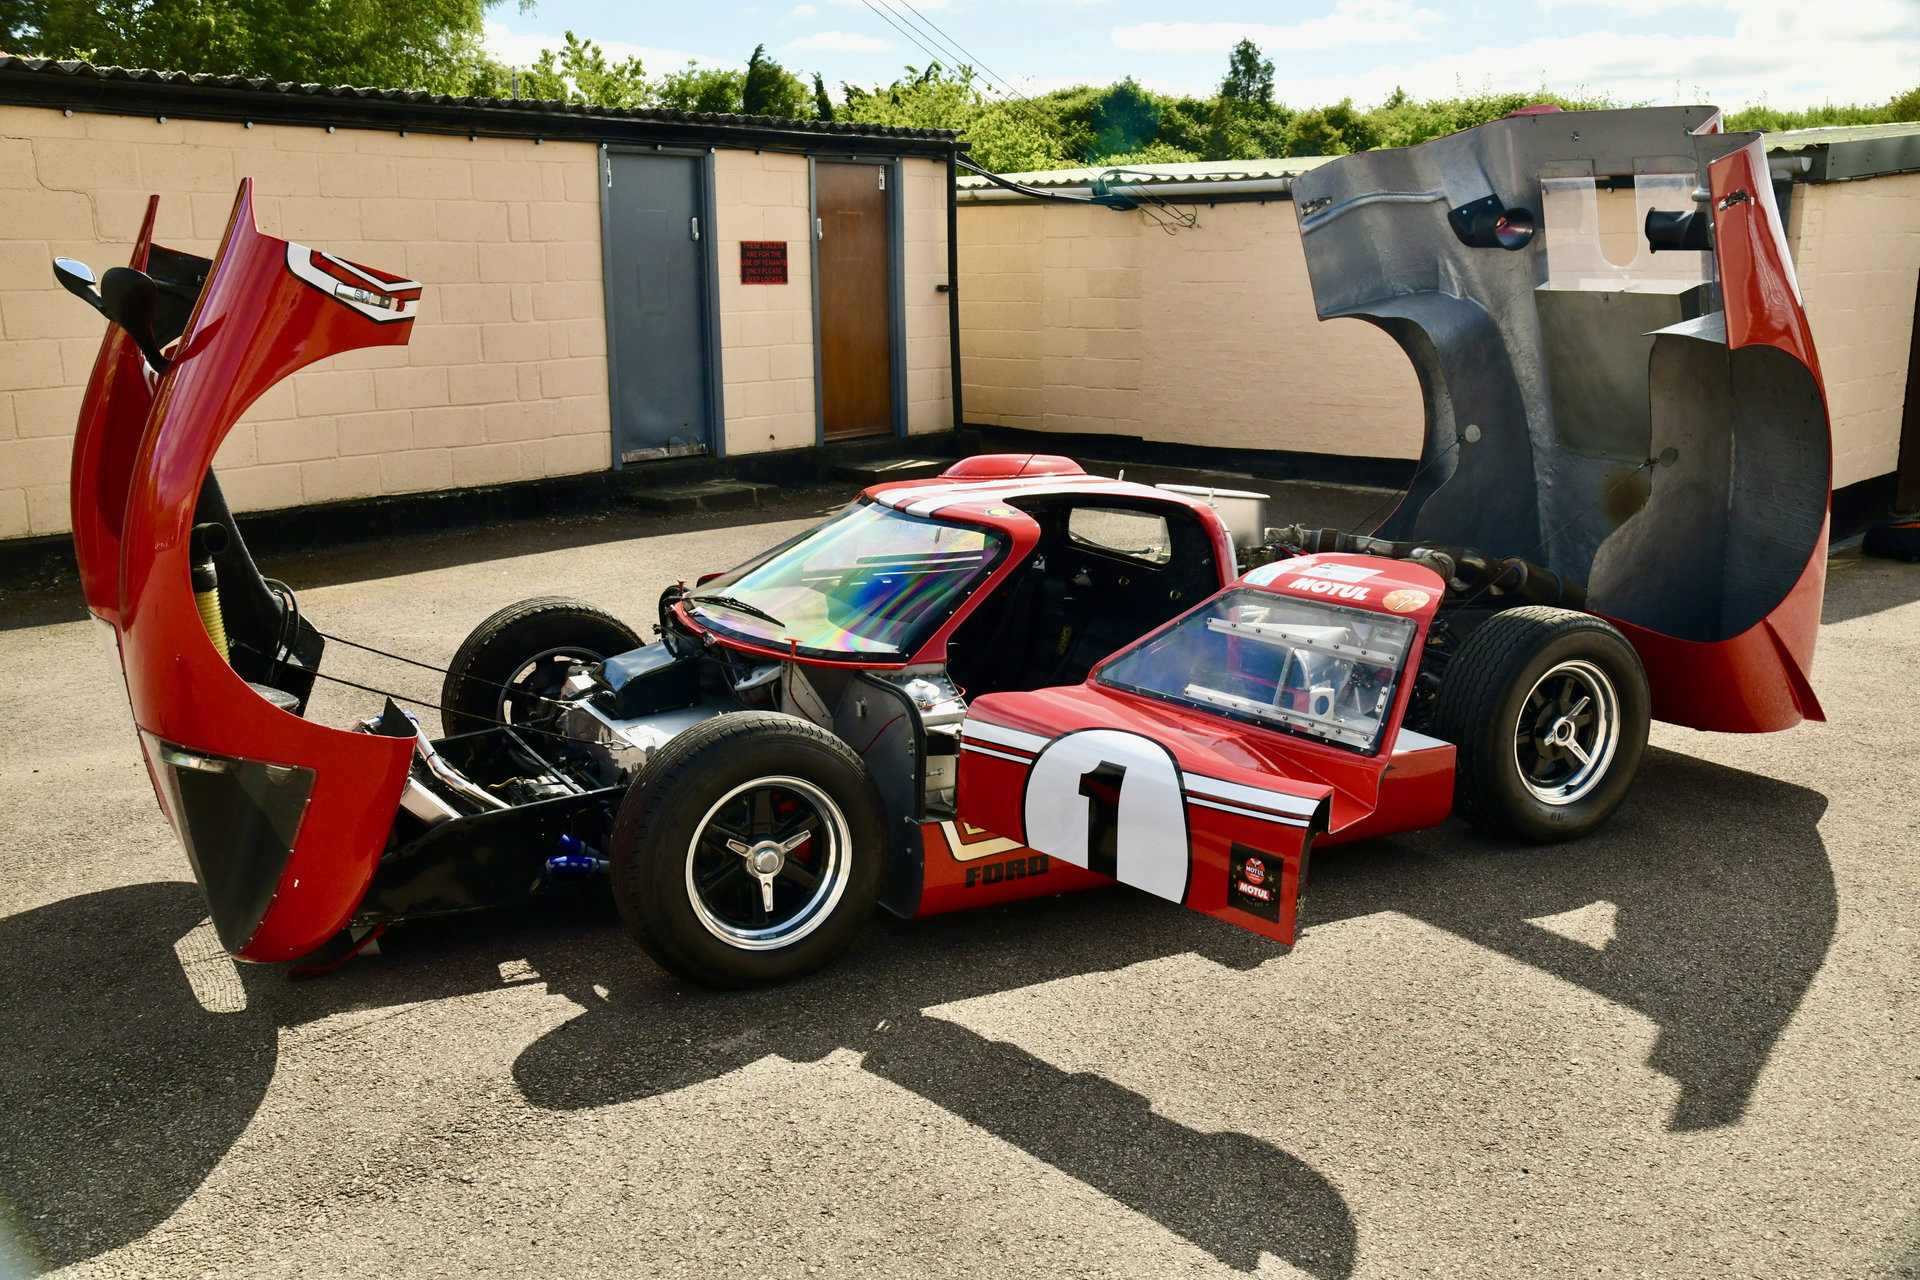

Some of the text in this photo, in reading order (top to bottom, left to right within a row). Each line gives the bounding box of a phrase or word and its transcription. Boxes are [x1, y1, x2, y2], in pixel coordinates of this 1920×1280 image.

[1288, 578, 1371, 600] MOTUL
[1078, 760, 1127, 880] 1
[965, 854, 1049, 888] FORD
[1245, 866, 1264, 876] MOTUL
[1239, 882, 1269, 899] MOTUL
